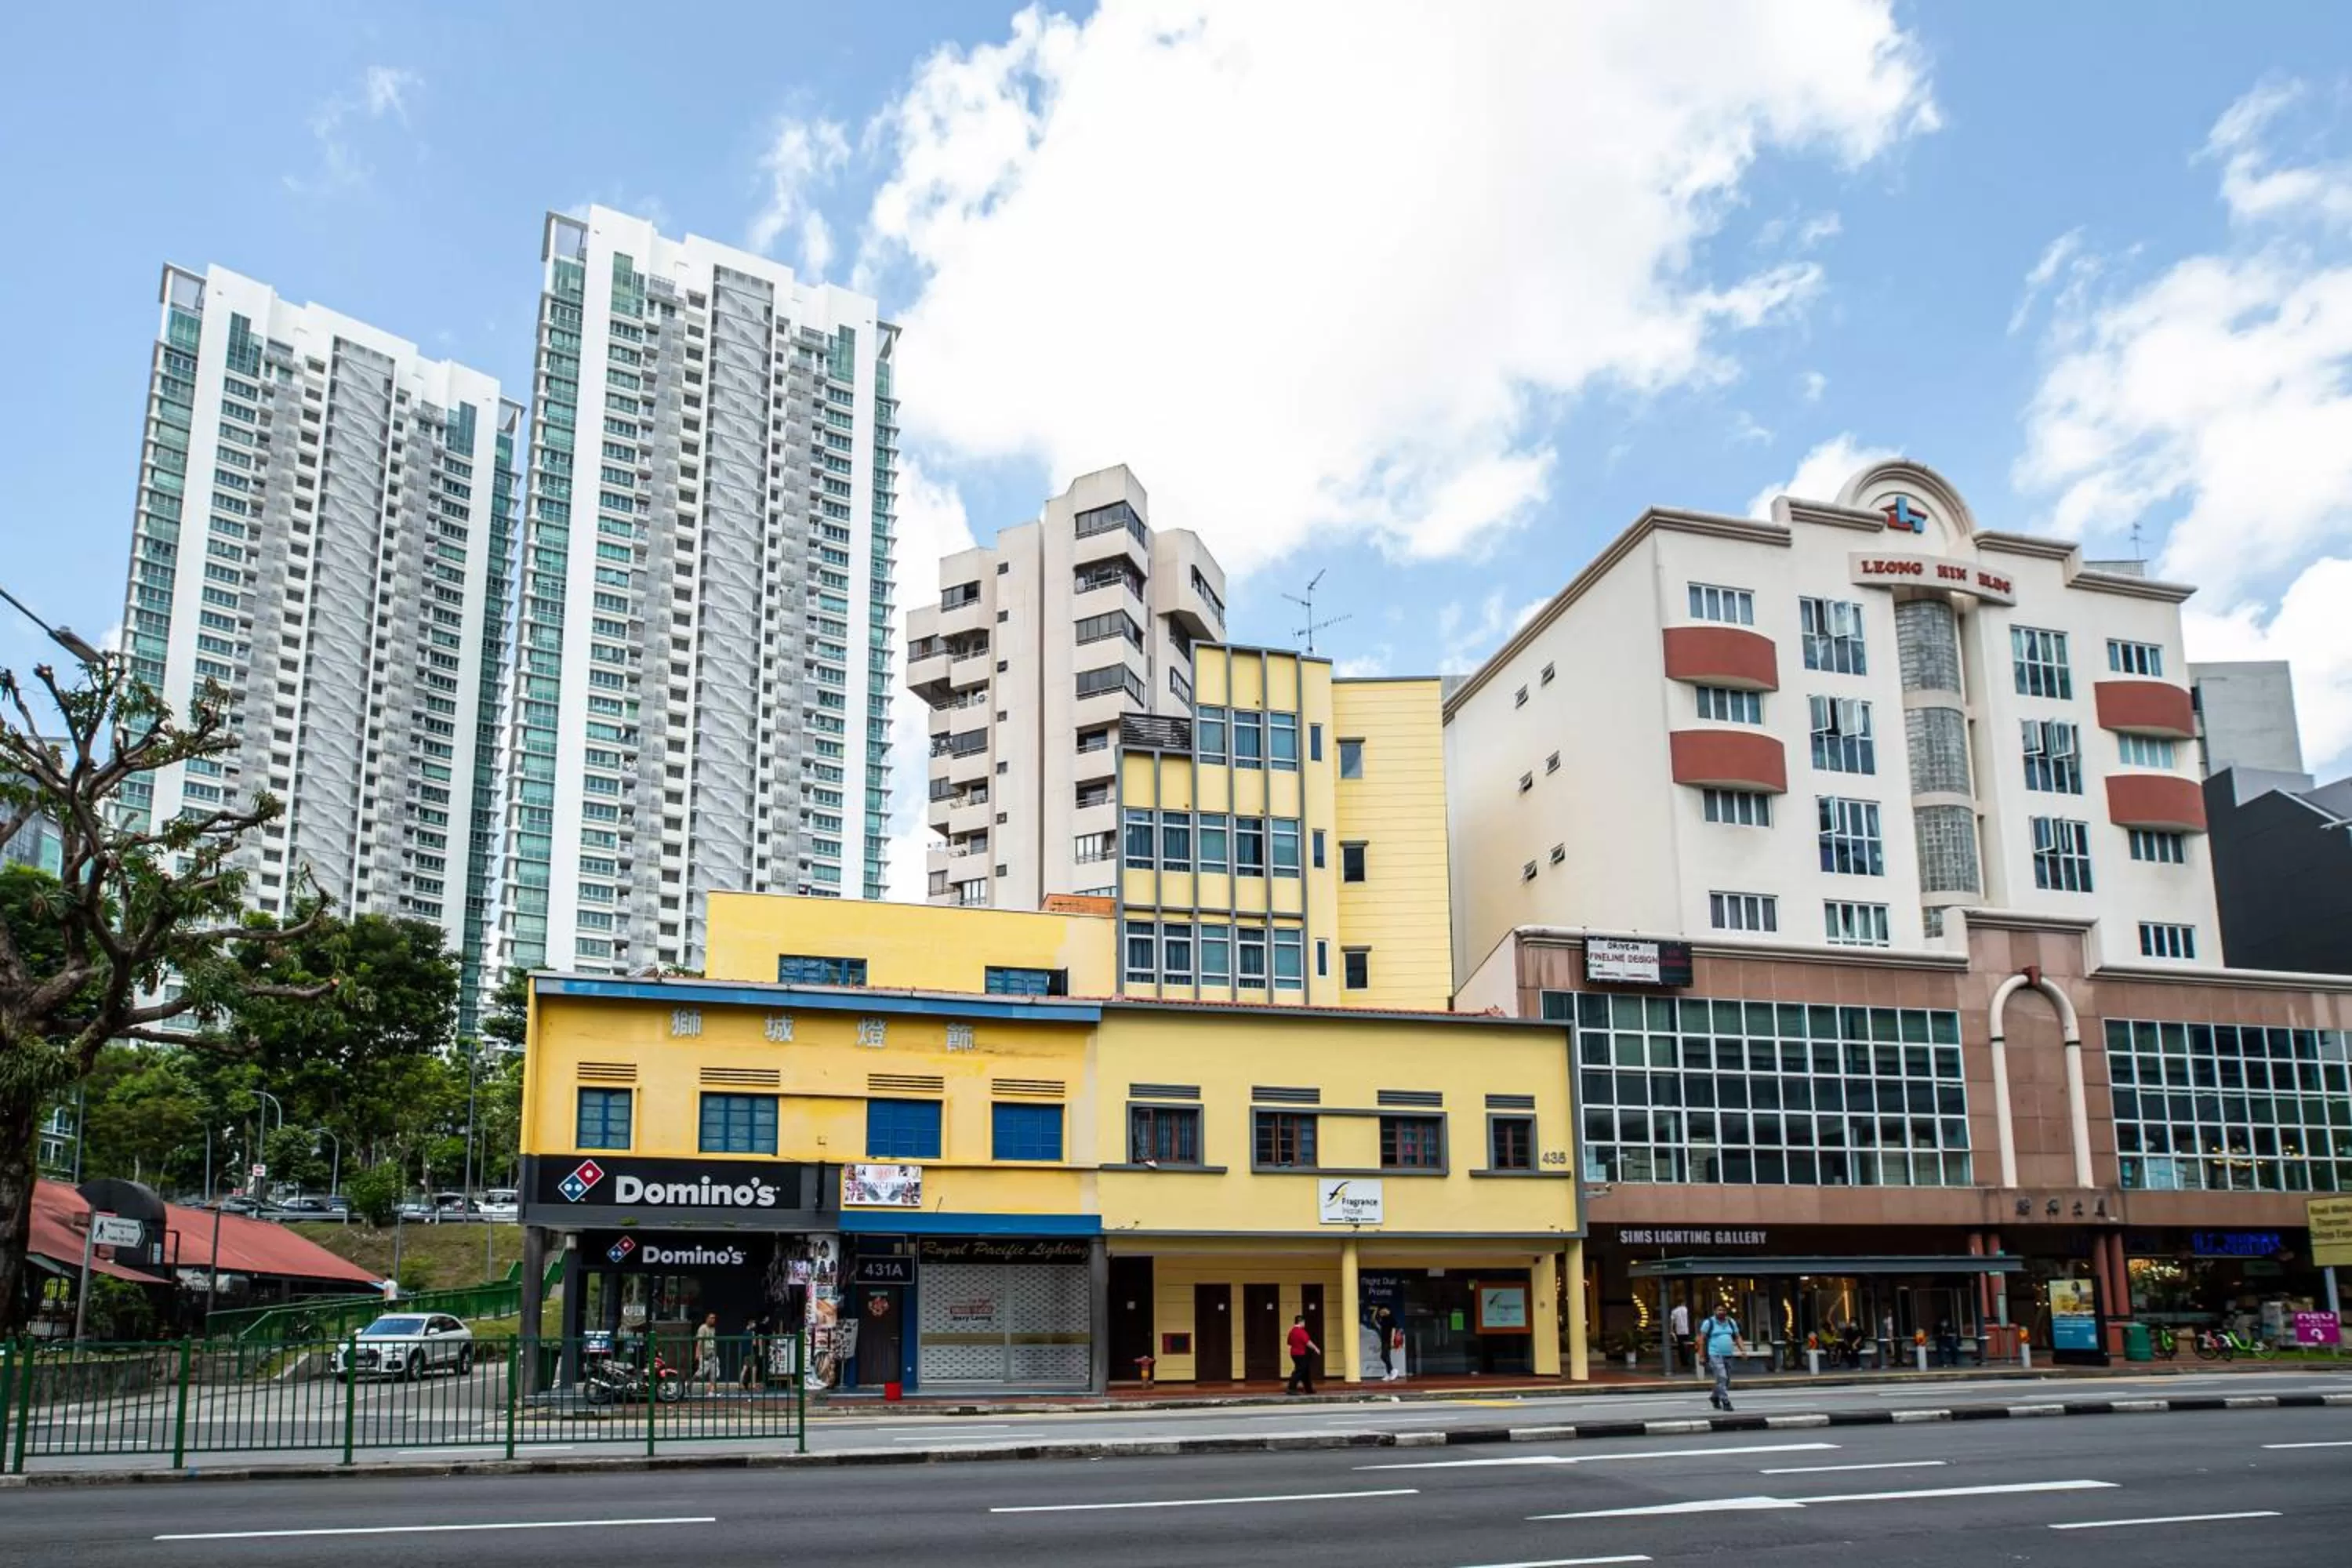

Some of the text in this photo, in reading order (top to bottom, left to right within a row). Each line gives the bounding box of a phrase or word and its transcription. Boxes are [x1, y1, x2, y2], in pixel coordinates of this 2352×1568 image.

[1861, 561, 2011, 593] LEONG HIN BLDG
[1589, 953, 1624, 962] FINELINE
[1628, 955, 1658, 964] DESIGN
[615, 1175, 776, 1207] Domino's
[1341, 1197, 1378, 1207] Fragrance
[1620, 1229, 1767, 1244] SIMS LIGHTING GALLERY
[642, 1245, 744, 1265] Domino's
[921, 1241, 1091, 1261] Royal Pacific Lighting
[865, 1263, 903, 1276] 431A
